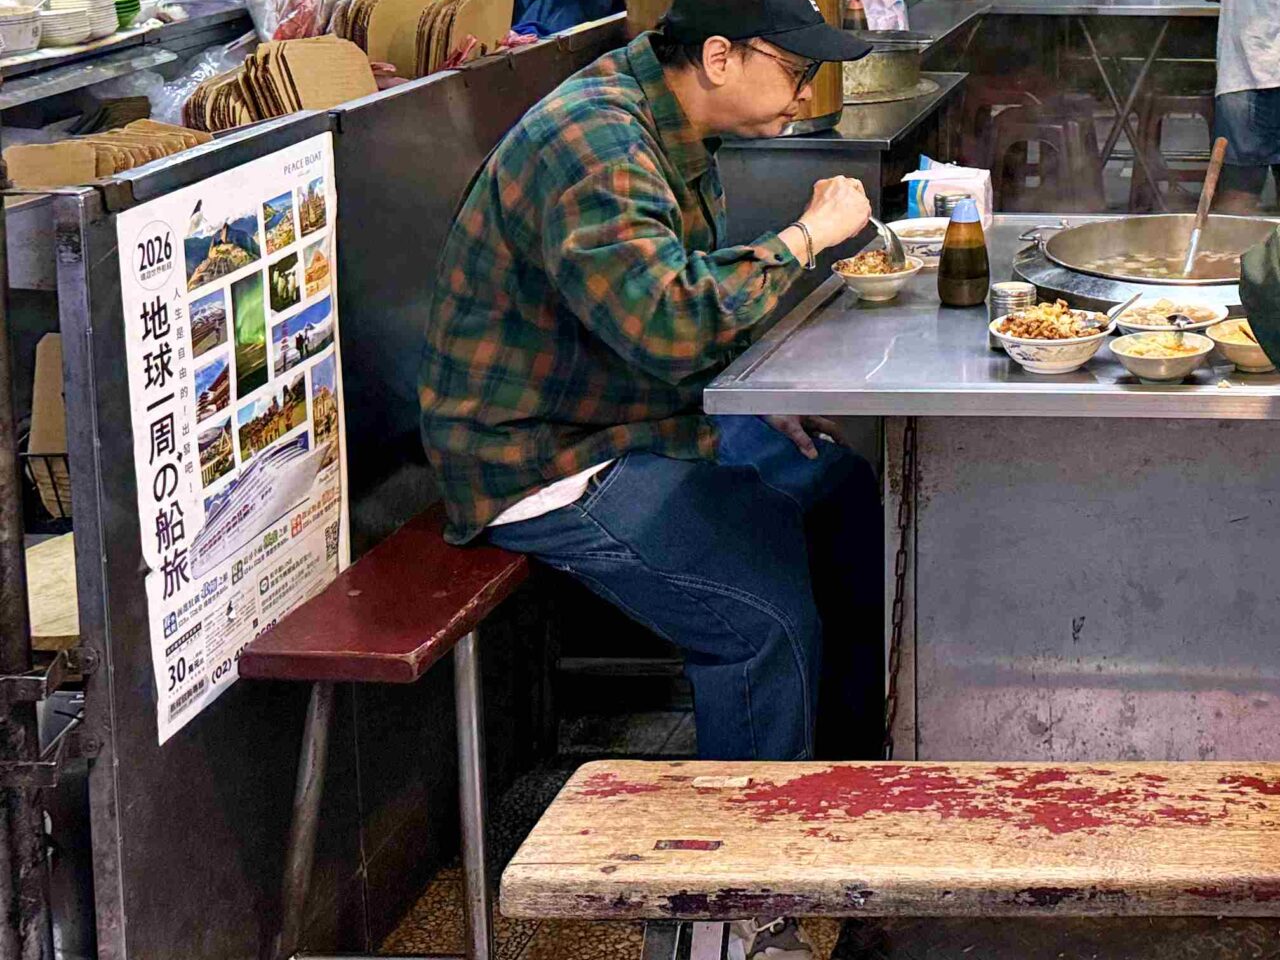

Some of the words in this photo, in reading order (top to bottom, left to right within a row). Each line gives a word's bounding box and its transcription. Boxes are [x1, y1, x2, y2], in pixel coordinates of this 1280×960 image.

[283, 158, 304, 175] PEACE
[304, 150, 322, 166] BOAT
[137, 231, 172, 272] 2026
[139, 294, 190, 601] 地球一周の船旅
[167, 656, 186, 692] 30
[211, 658, 232, 685] (02)
